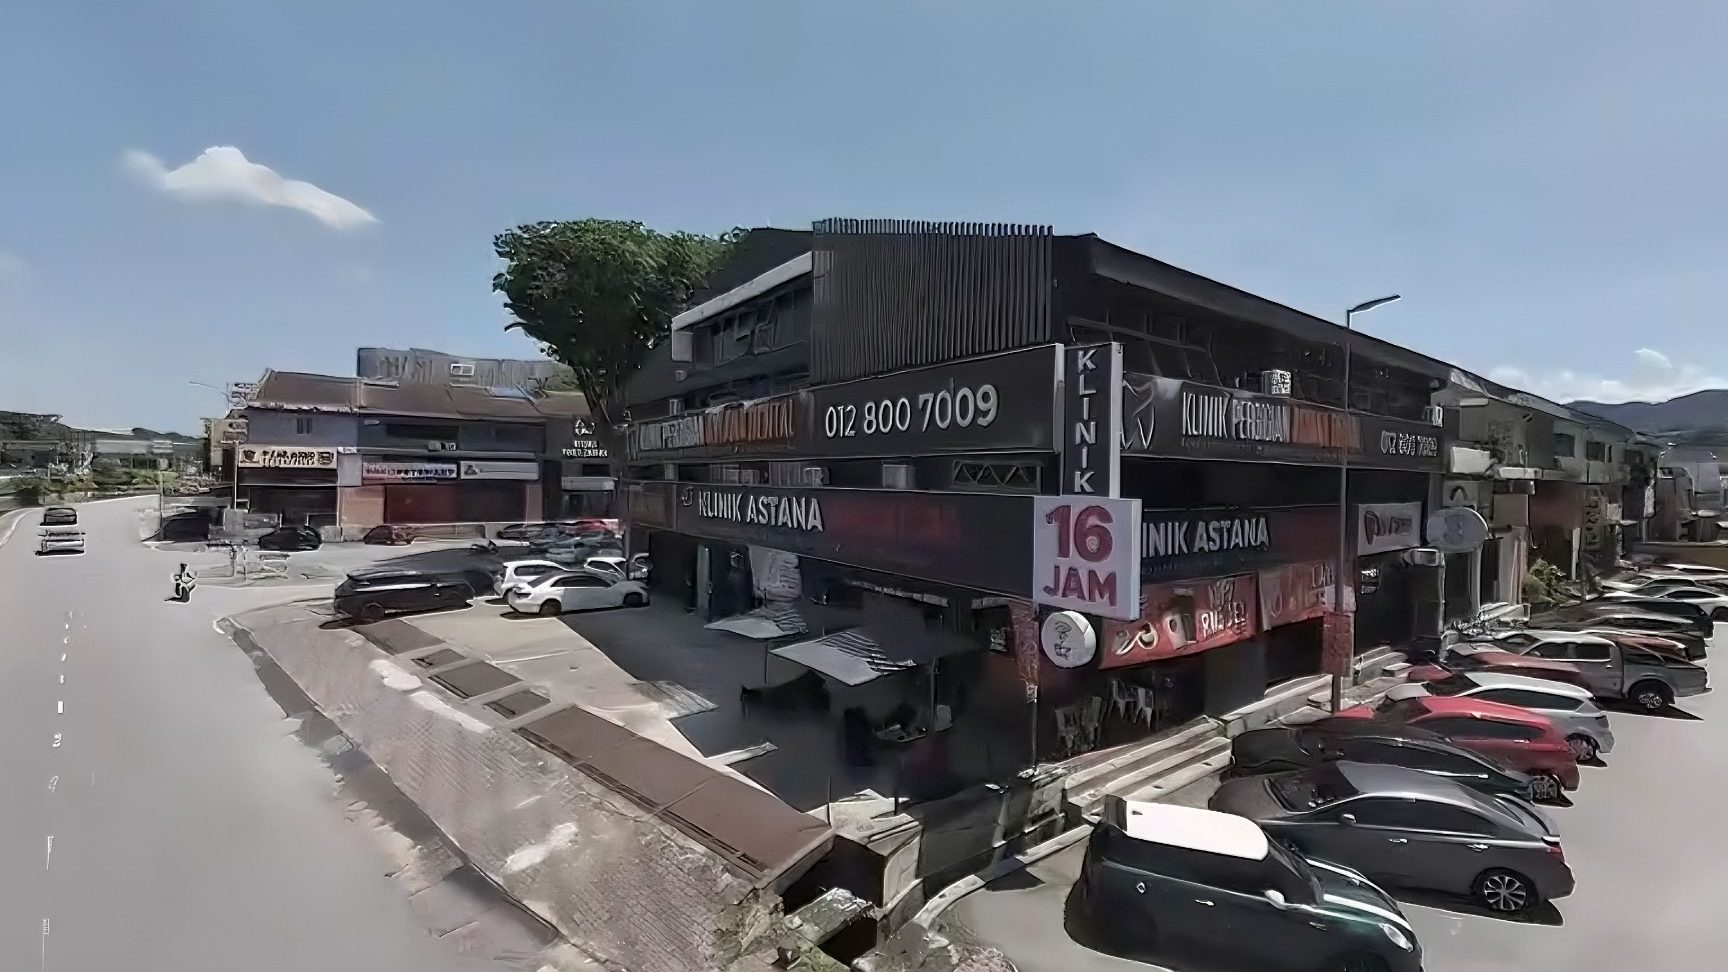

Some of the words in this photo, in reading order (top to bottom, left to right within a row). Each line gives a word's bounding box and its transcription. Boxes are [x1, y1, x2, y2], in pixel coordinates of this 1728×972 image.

[825, 404, 857, 438] 012
[863, 397, 911, 435] 800
[918, 384, 999, 433] 7009
[1074, 349, 1097, 493] KLINIK
[1182, 391, 1231, 439] KLINIK
[699, 491, 742, 522] KLINIK
[746, 495, 824, 532] ASTANA
[1045, 505, 1114, 563] 16
[1192, 517, 1269, 553] ASTANA
[1043, 565, 1118, 607] JAM
